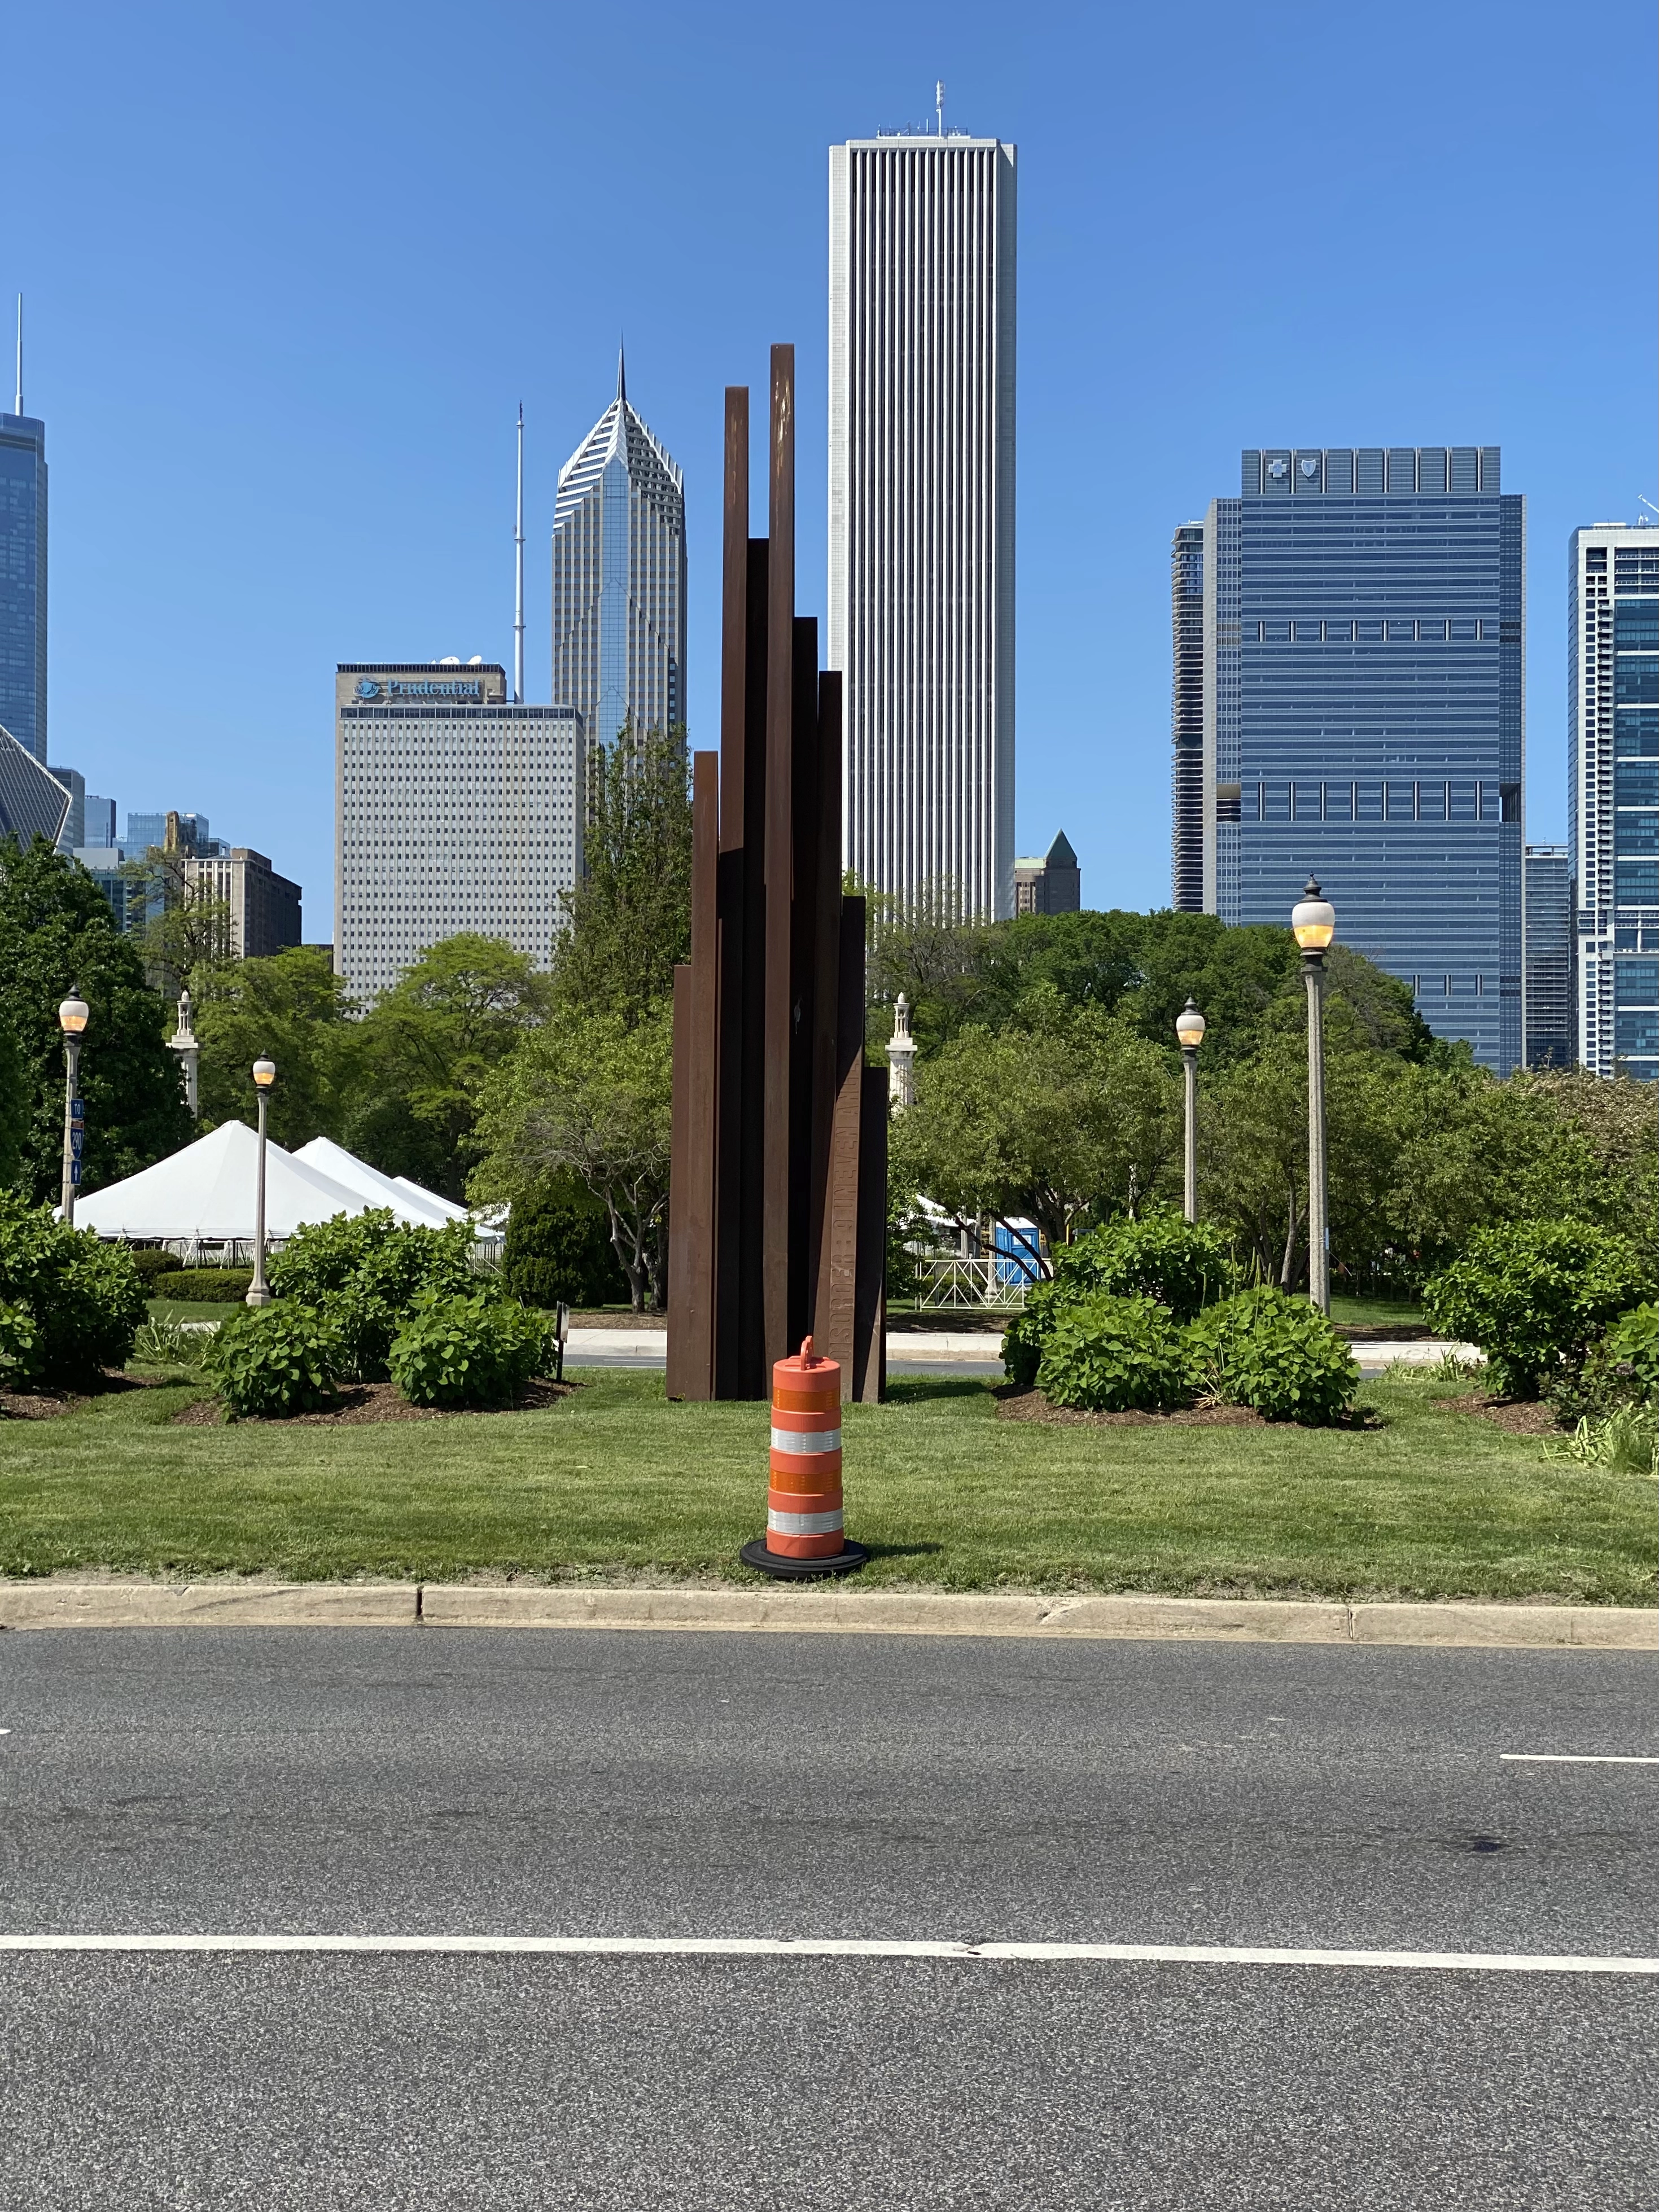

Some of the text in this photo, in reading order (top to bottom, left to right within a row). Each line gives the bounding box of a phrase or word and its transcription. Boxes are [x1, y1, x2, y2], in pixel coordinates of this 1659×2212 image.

[387, 678, 480, 695] Prudential
[74, 1103, 81, 1115] TO
[72, 1132, 82, 1150] 290
[834, 1126, 859, 1208] UNEVEN
[833, 1219, 855, 1233] 9
[829, 1254, 855, 1361] DISORDER
